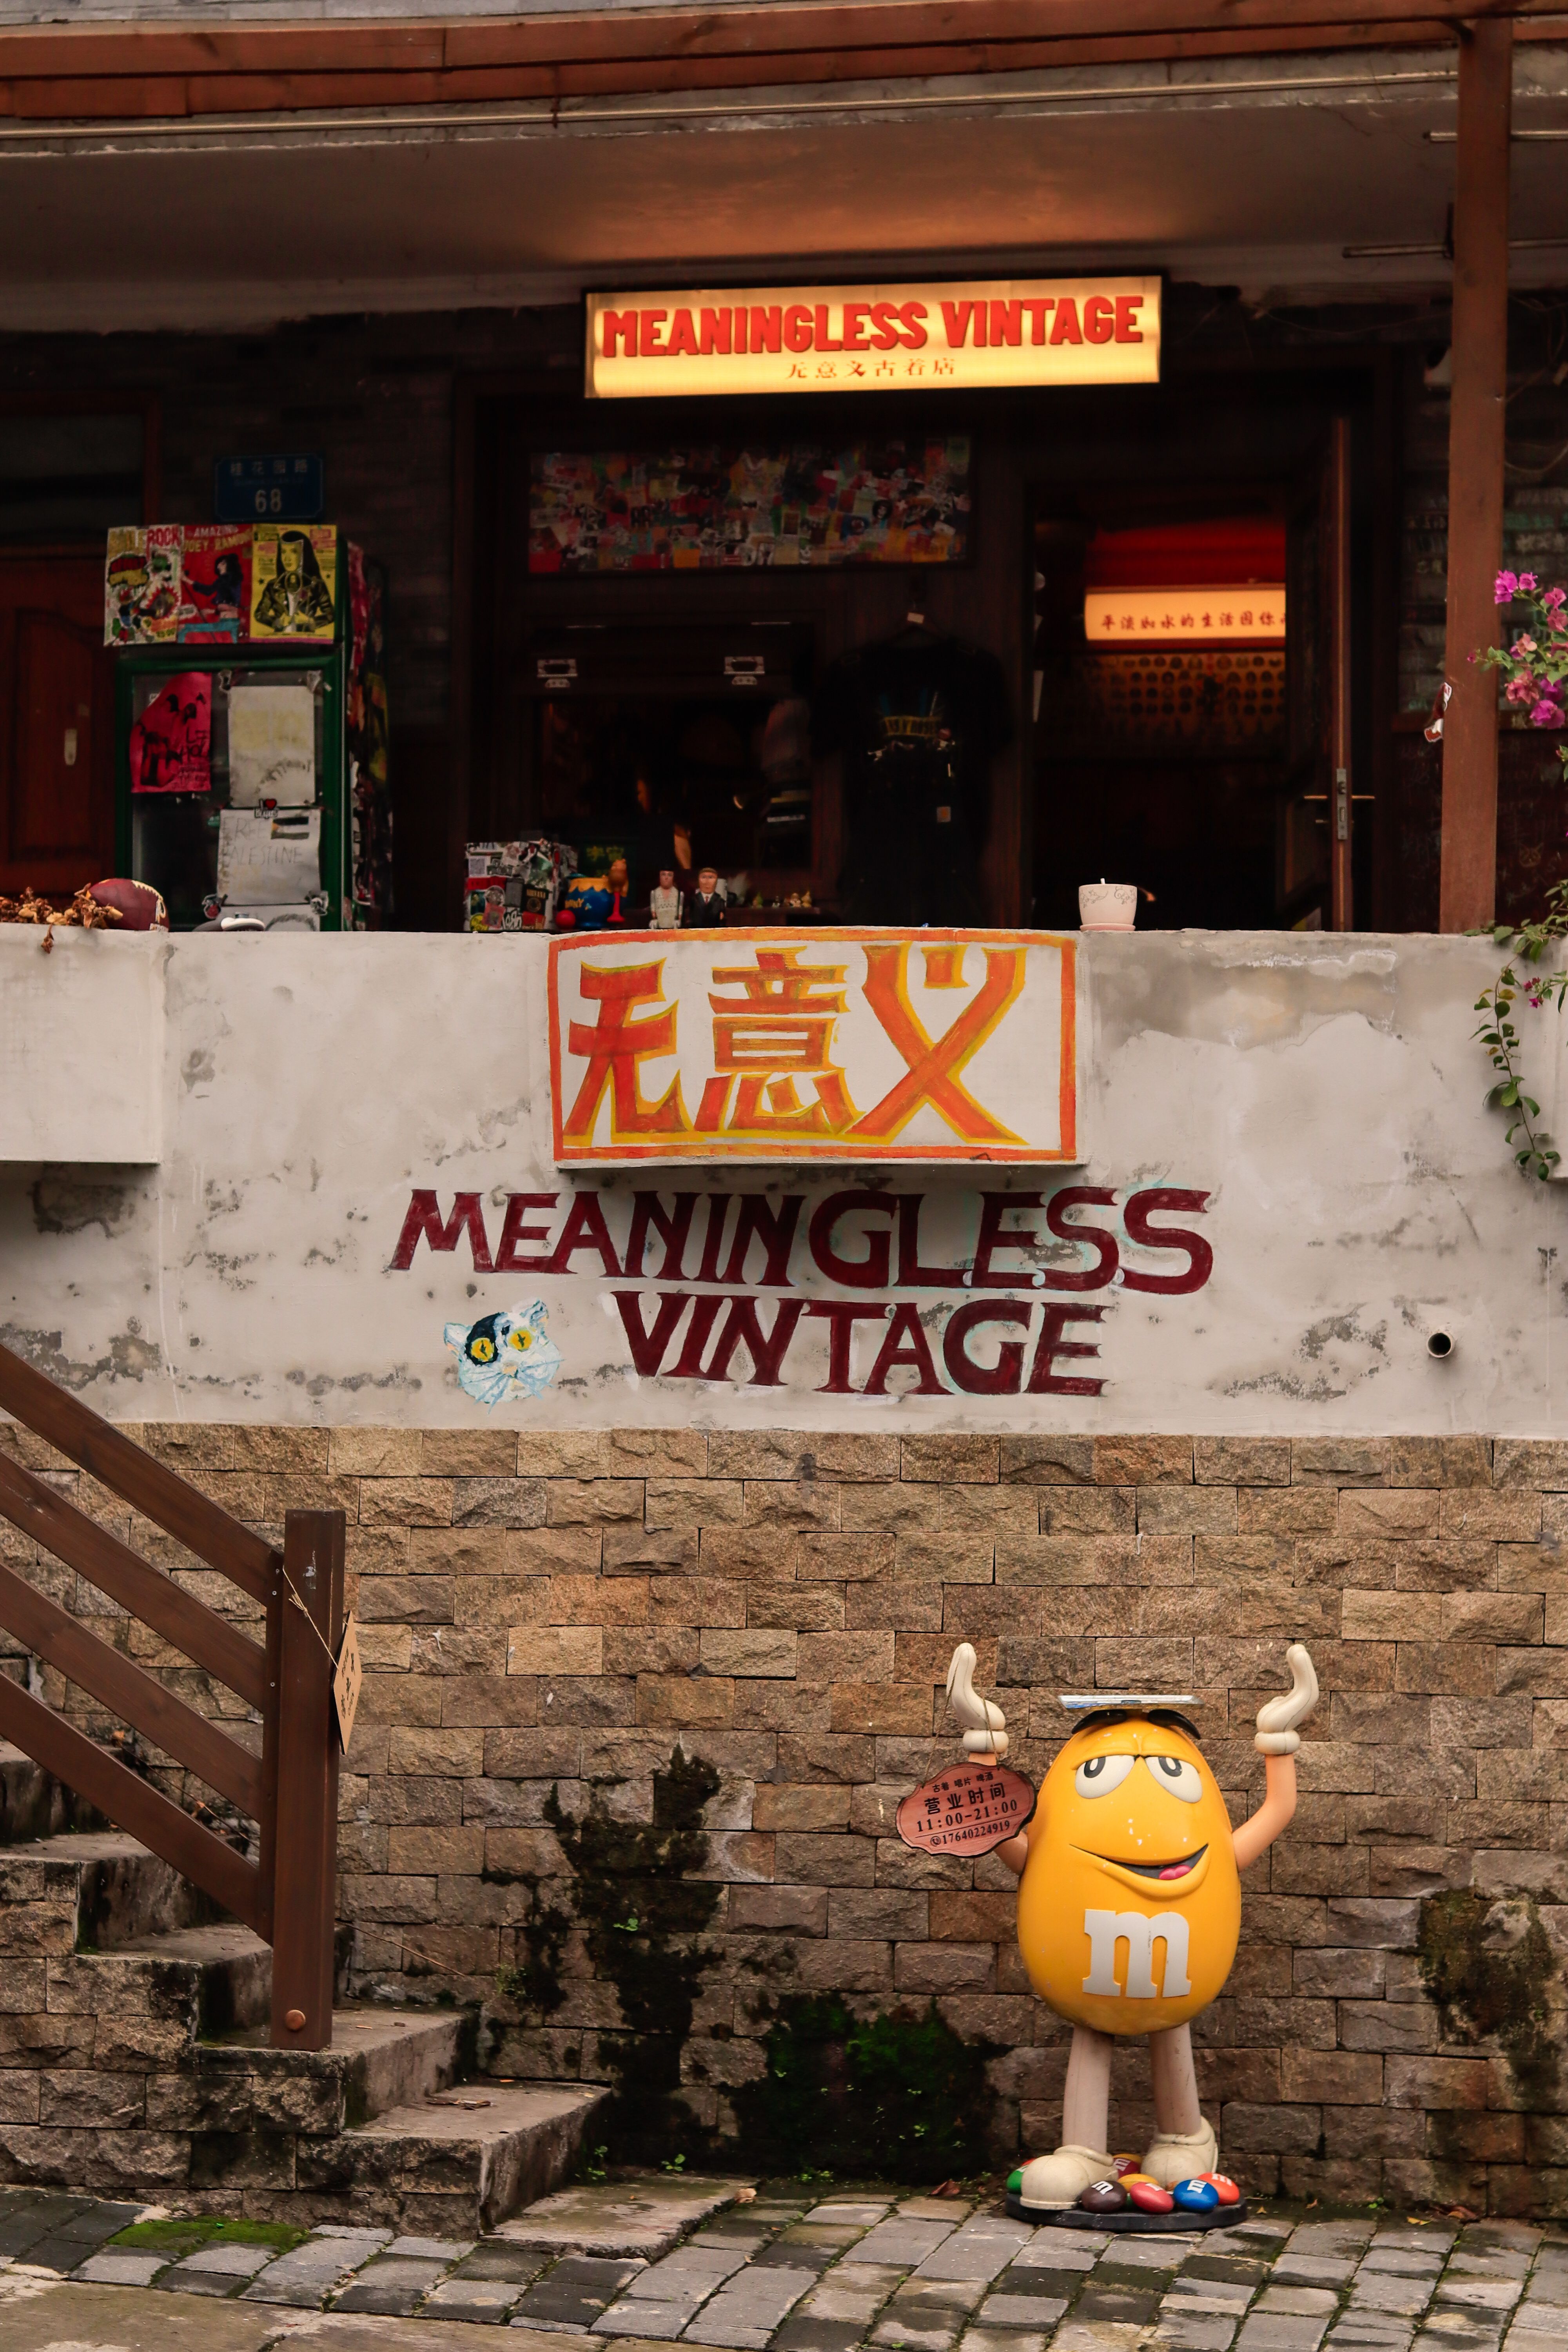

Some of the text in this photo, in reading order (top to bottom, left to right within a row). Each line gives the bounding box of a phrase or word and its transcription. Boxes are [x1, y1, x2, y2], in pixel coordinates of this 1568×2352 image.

[601, 296, 1144, 359] MEANINGLESS VINTAGE
[255, 488, 281, 513] 68
[562, 941, 1030, 1145] 无意义
[392, 1186, 1214, 1295] MEANINGLESS
[610, 1291, 1110, 1397] VINTAGE
[924, 1782, 1006, 1815] 营业时间
[954, 1777, 972, 1788] 唱片
[976, 1771, 994, 1782] 啤酒
[917, 1799, 1018, 1832] 11:00-21:00
[942, 1820, 1011, 1845] 17640224919
[1082, 1909, 1191, 1999] m
